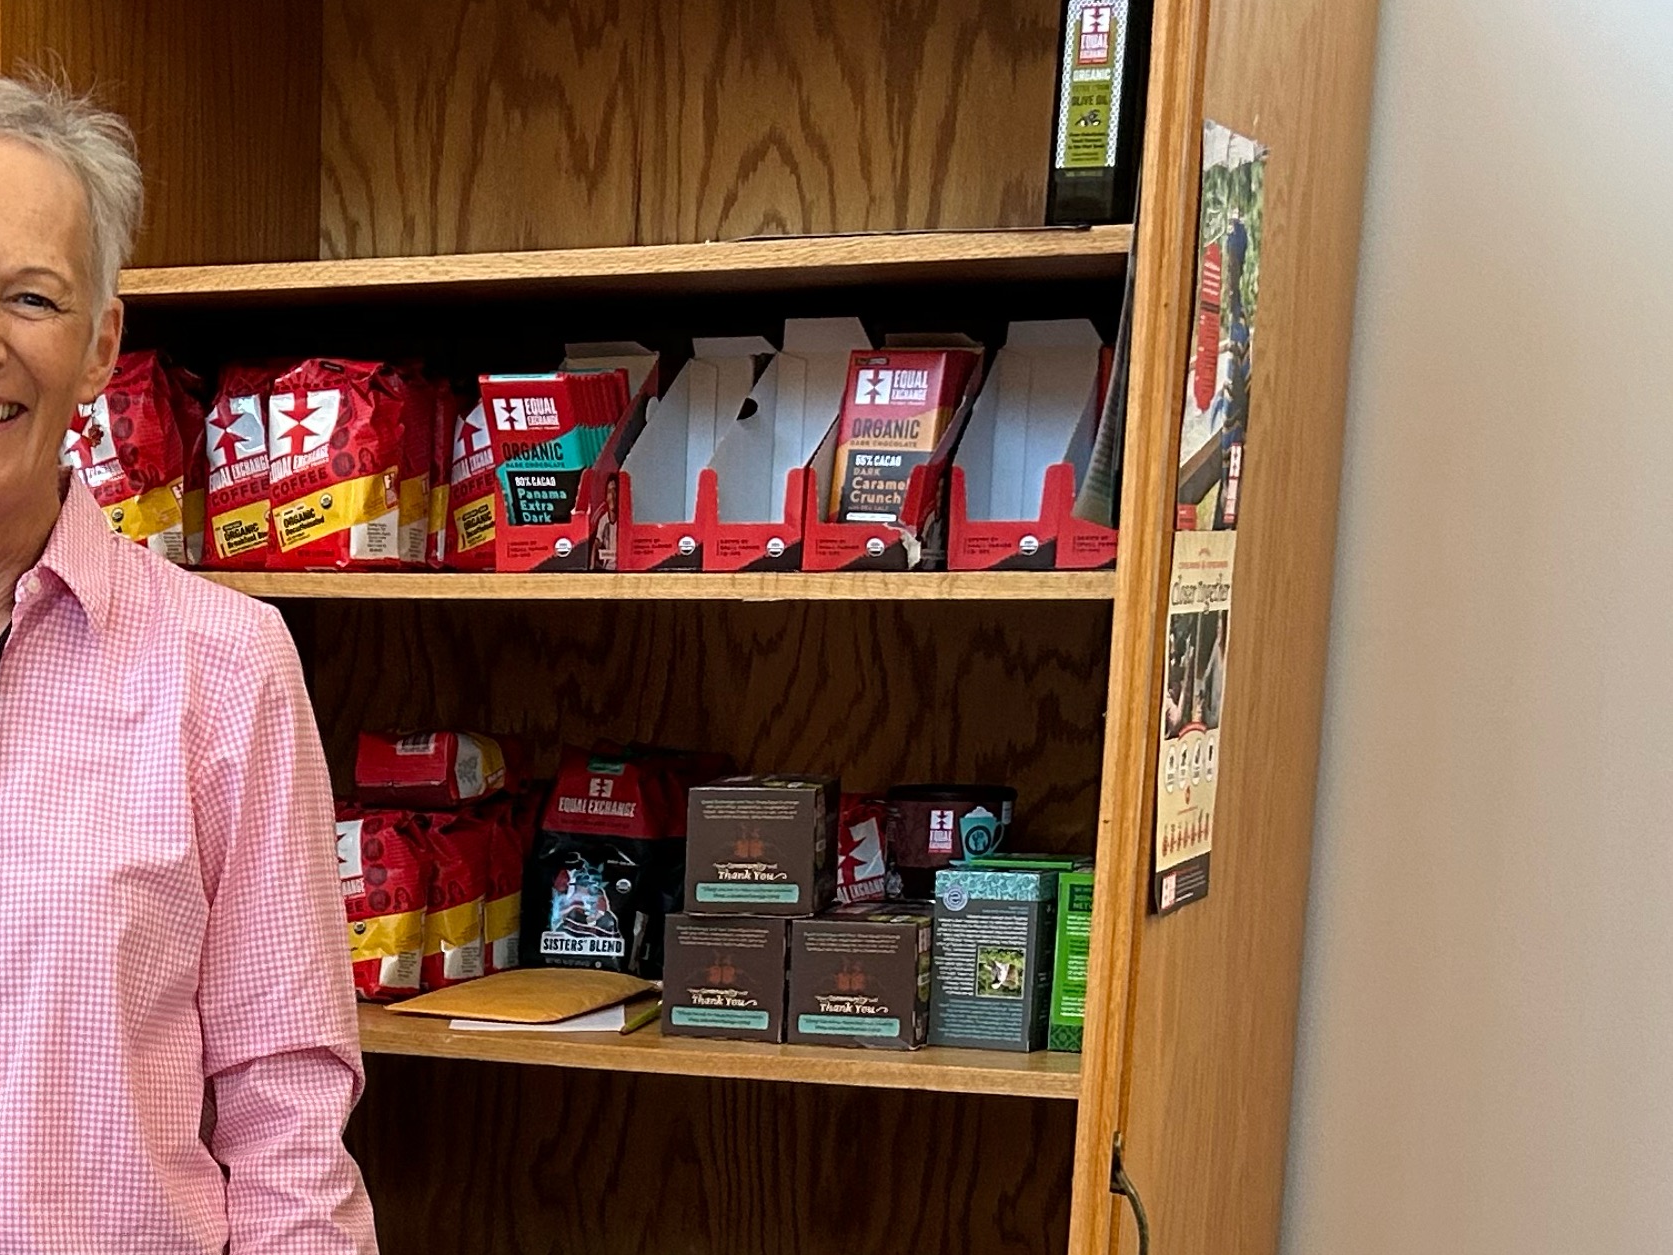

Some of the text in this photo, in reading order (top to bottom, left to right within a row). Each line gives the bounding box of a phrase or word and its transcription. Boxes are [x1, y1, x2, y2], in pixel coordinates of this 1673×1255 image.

[894, 371, 928, 388] EQUAL
[524, 397, 558, 415] EQUAL
[852, 418, 920, 439] ORGANIC
[502, 441, 564, 461] ORGANIC
[874, 455, 902, 466] CACAO
[853, 468, 880, 476] DARK
[272, 467, 329, 499] COFFEE
[453, 474, 493, 499] COFFE
[517, 488, 567, 500] Panama
[850, 490, 901, 504] Crunch
[519, 501, 555, 512] Extra
[522, 512, 552, 524] Dark
[558, 797, 636, 818] EQUAL EXCHANGE
[718, 868, 780, 881] Thank You
[543, 938, 623, 953] SISTERS' BLEND
[691, 994, 752, 1007] Thank You
[819, 1003, 881, 1015] Thank You
